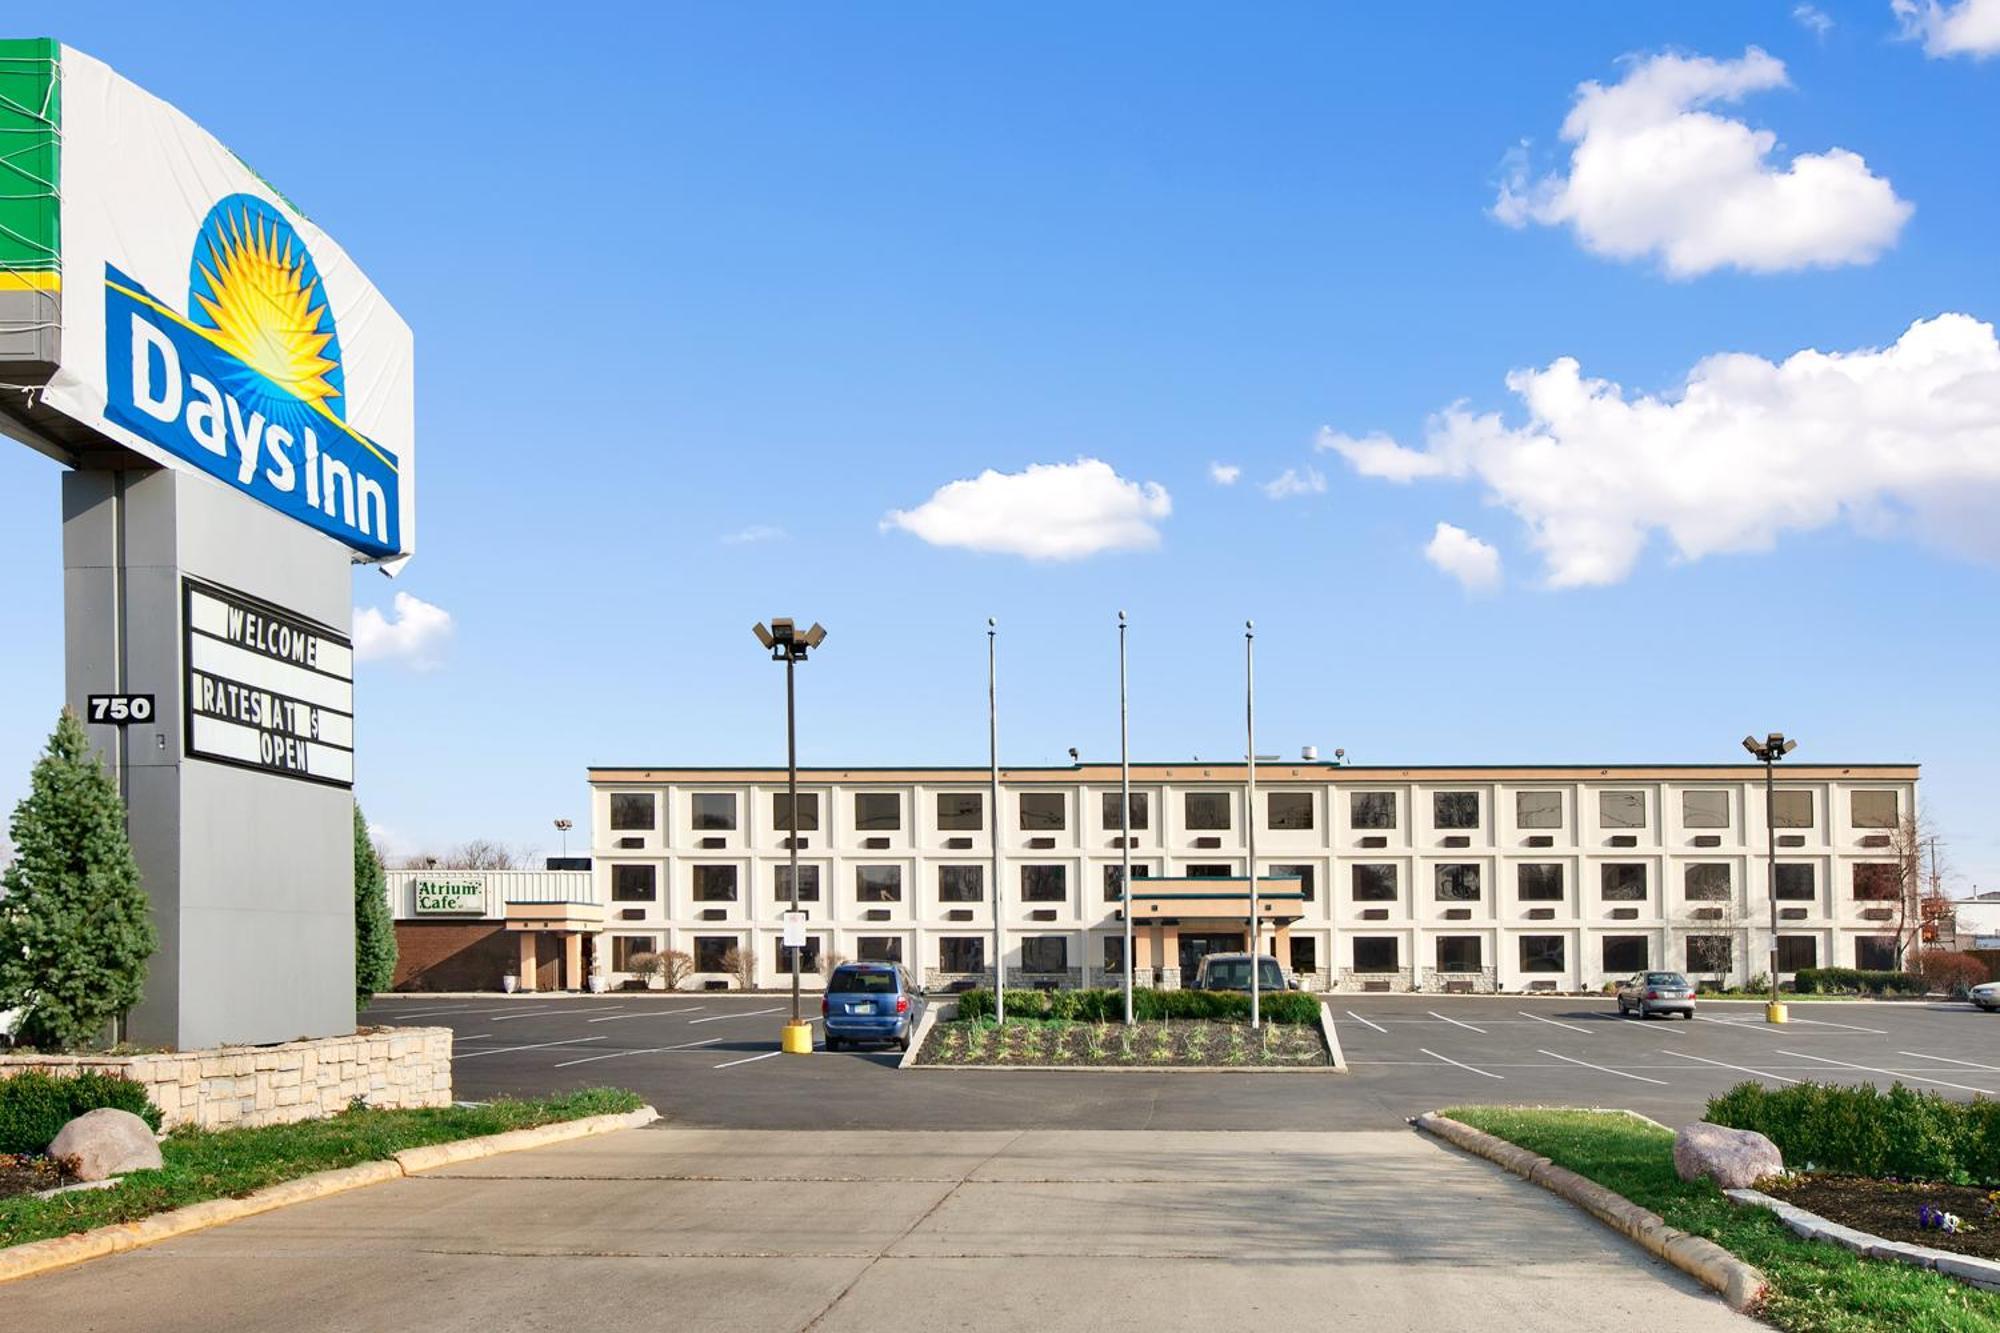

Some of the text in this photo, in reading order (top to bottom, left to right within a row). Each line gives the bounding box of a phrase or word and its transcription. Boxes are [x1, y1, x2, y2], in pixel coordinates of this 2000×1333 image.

[131, 312, 388, 544] Days Inn
[229, 607, 316, 666] WELCOME
[92, 698, 150, 719] 750
[204, 677, 261, 723] RATES
[273, 699, 294, 730] AT
[261, 735, 306, 770] OPEN
[420, 881, 477, 895] Atrium
